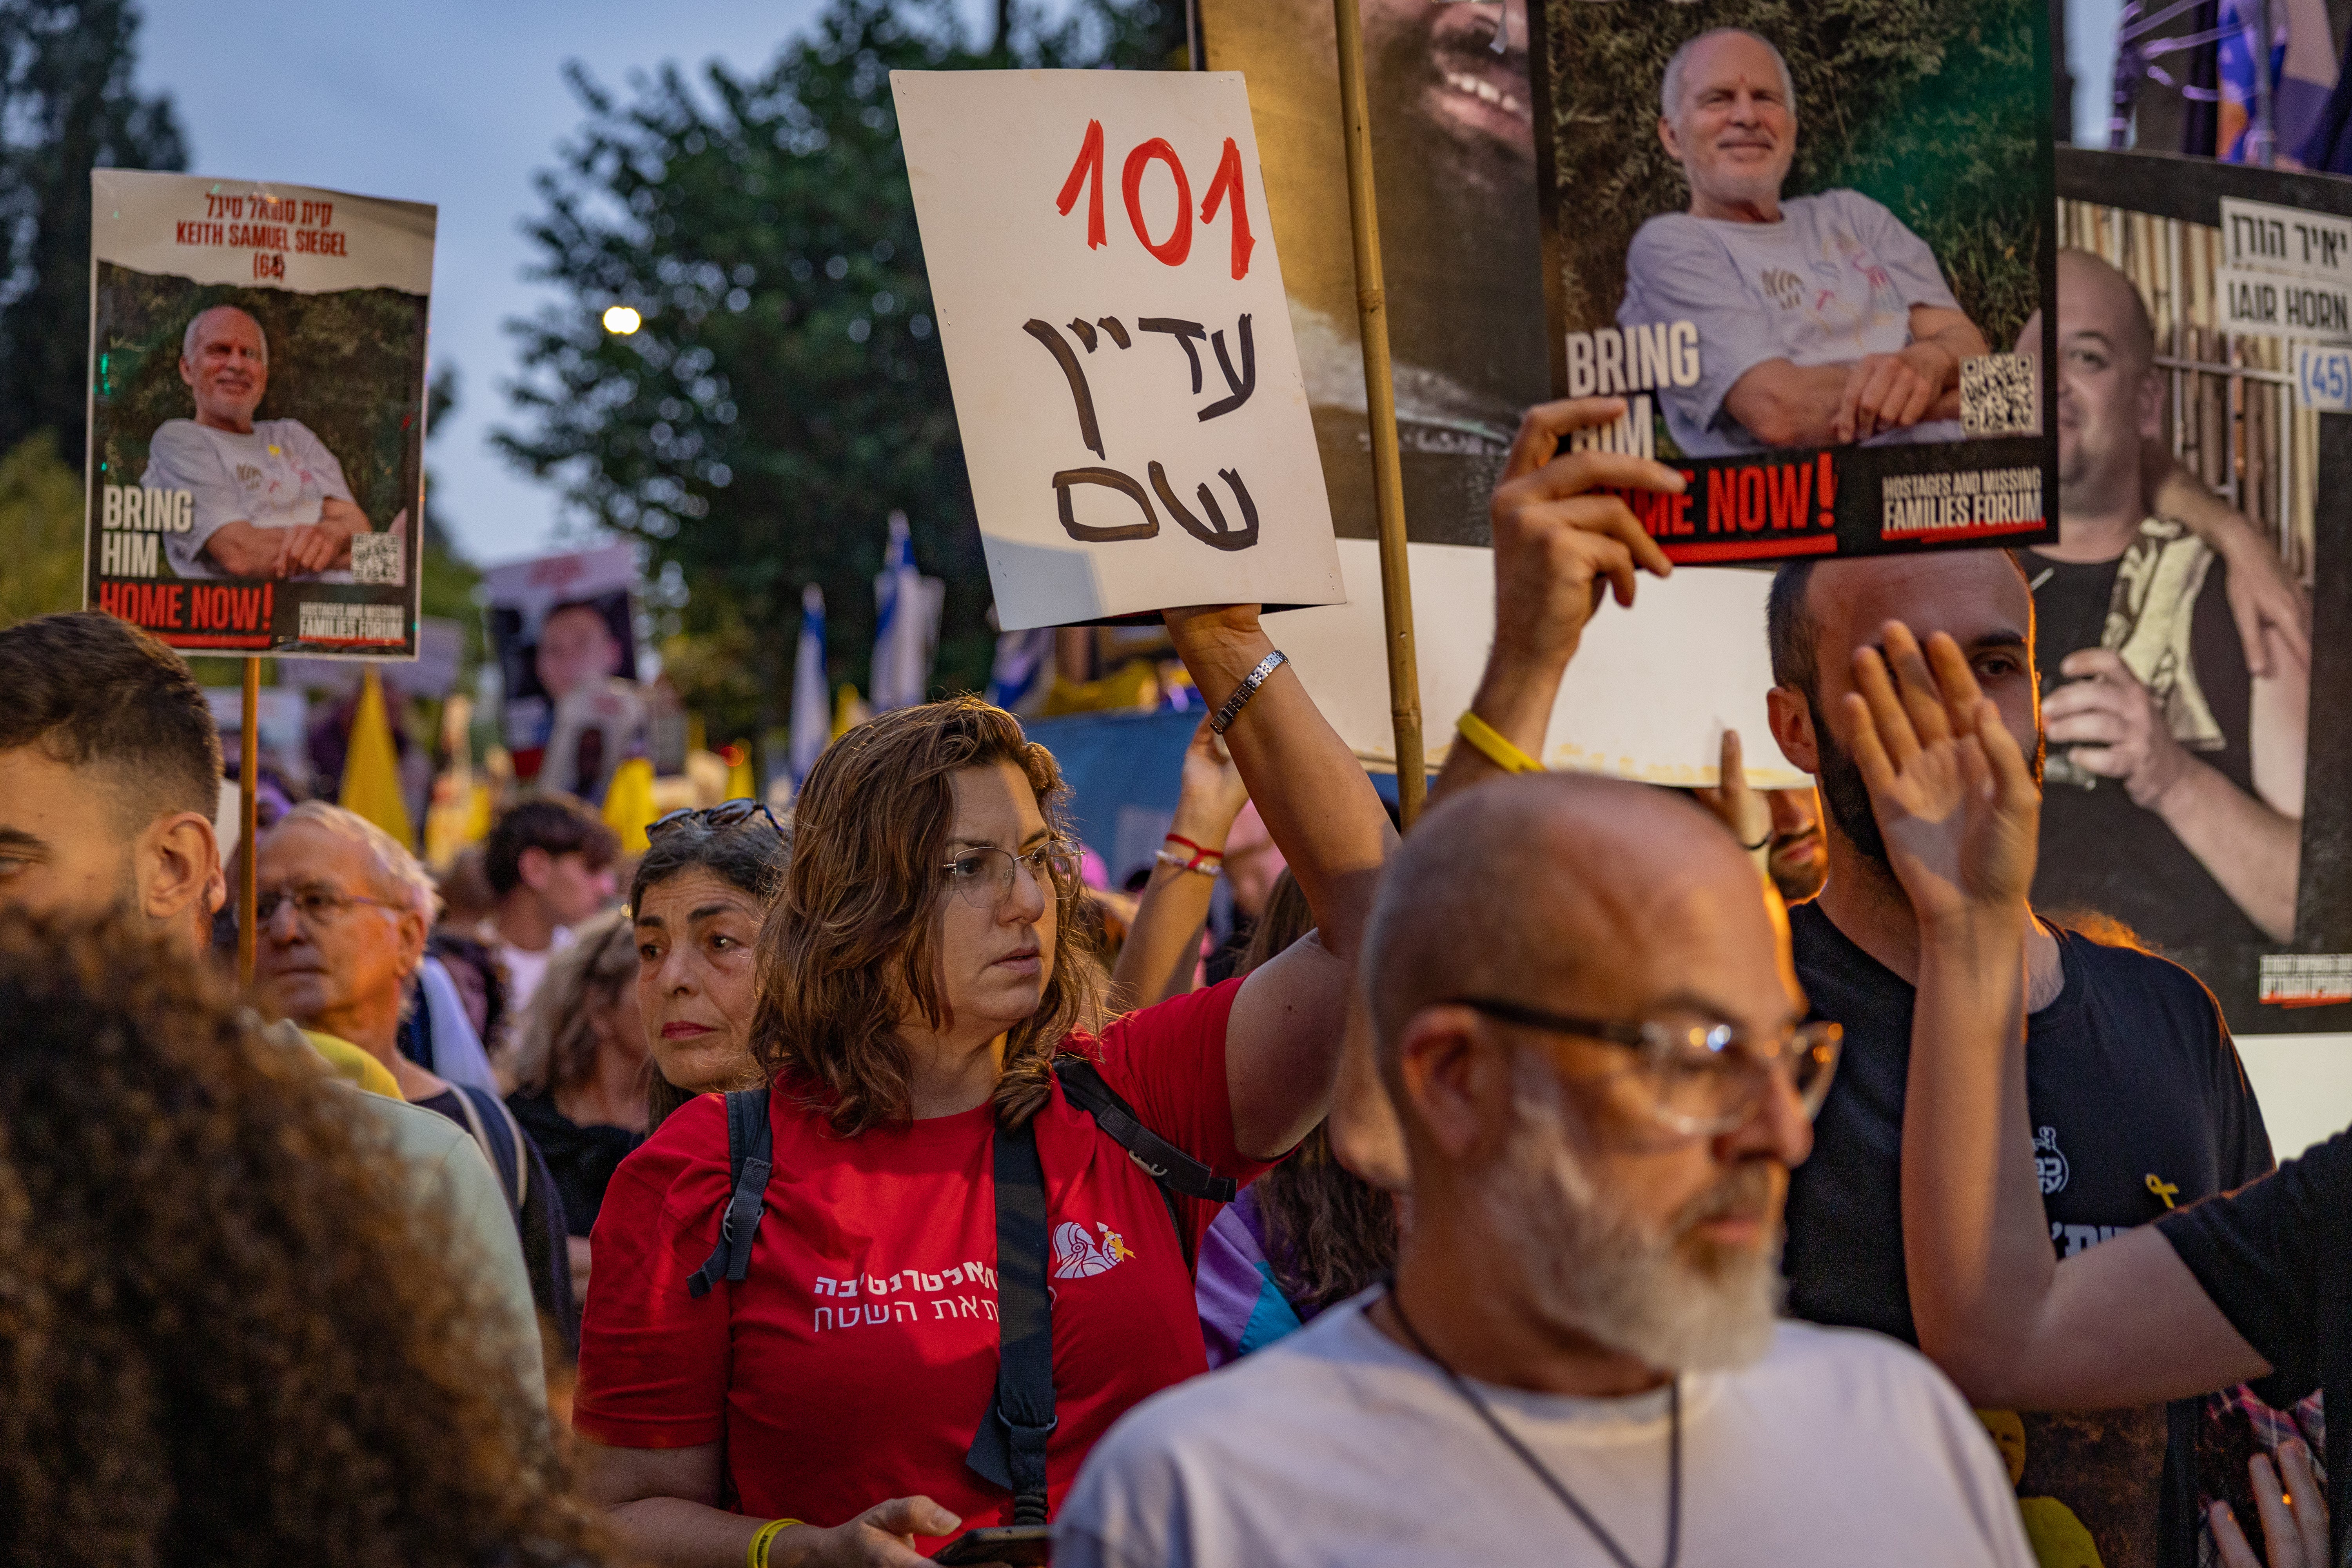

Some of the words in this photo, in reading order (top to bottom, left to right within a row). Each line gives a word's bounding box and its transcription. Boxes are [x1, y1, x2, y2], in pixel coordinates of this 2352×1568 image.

[1055, 118, 1256, 281] 101
[177, 221, 223, 246] KEITH
[229, 223, 291, 253] SAMUEL
[296, 228, 347, 257] SIEGEL
[2293, 222, 2347, 270] יאיר
[2229, 280, 2276, 325] IAIR
[2286, 284, 2348, 330] HORN
[1566, 320, 1701, 397] BRING
[2301, 350, 2352, 408] (45)
[1022, 313, 1256, 461] עדיין
[1052, 460, 1259, 552] שם
[1707, 451, 1836, 534] NOW!
[1882, 472, 1952, 500] HOSTAGES
[1953, 470, 1981, 496] AND
[1982, 466, 2042, 494] MISSING
[102, 484, 193, 534] BRING
[1883, 495, 1971, 532] FAMILIES
[1973, 490, 2043, 527] FORUM
[100, 532, 159, 578] HIM
[100, 581, 184, 629] HOME
[191, 583, 274, 631] NOW!
[299, 615, 356, 637] FAMILIES
[358, 618, 404, 640] FORUM
[814, 1261, 985, 1298] אלטרנטיבה
[814, 1301, 918, 1333] השטח
[931, 1295, 979, 1319] את
